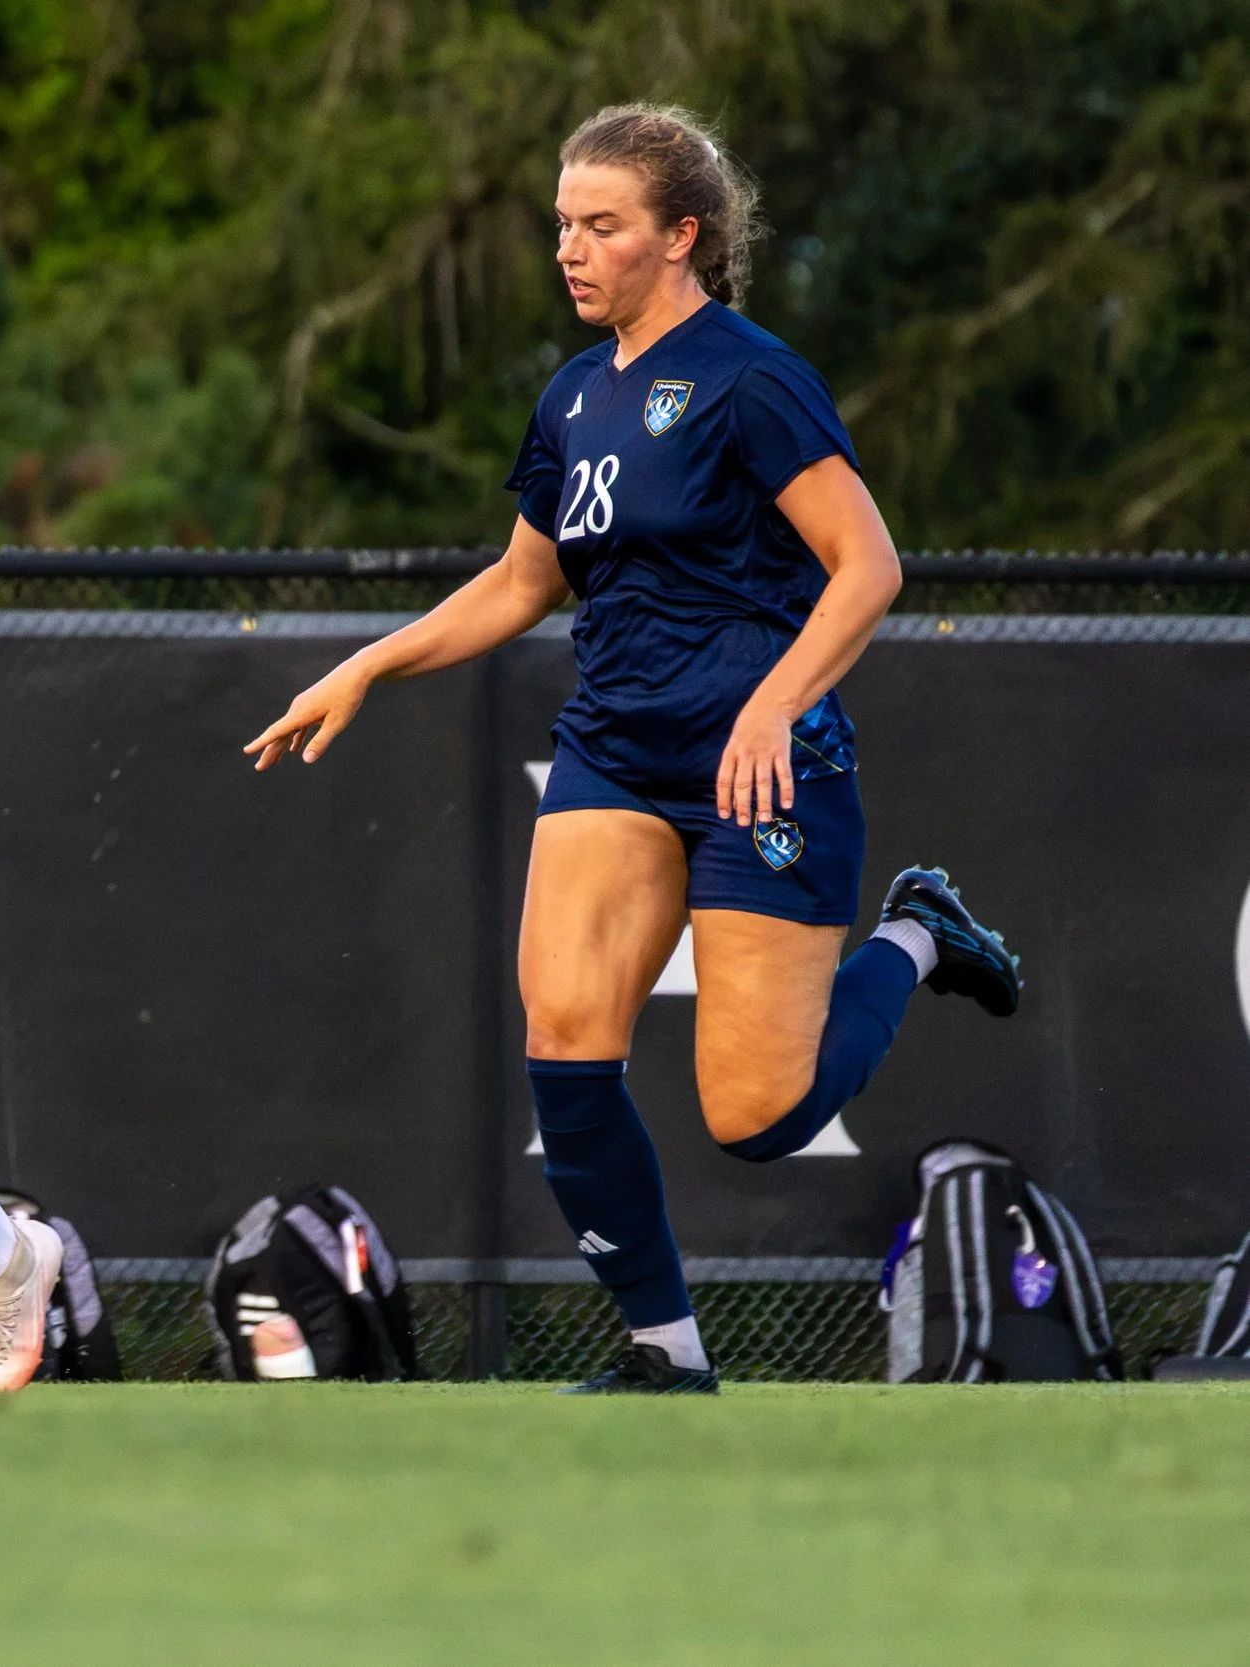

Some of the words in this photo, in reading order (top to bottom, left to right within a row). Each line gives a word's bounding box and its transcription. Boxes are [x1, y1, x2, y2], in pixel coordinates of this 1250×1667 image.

[656, 396, 672, 418] Q
[559, 454, 620, 541] 28
[770, 832, 791, 854] Q
